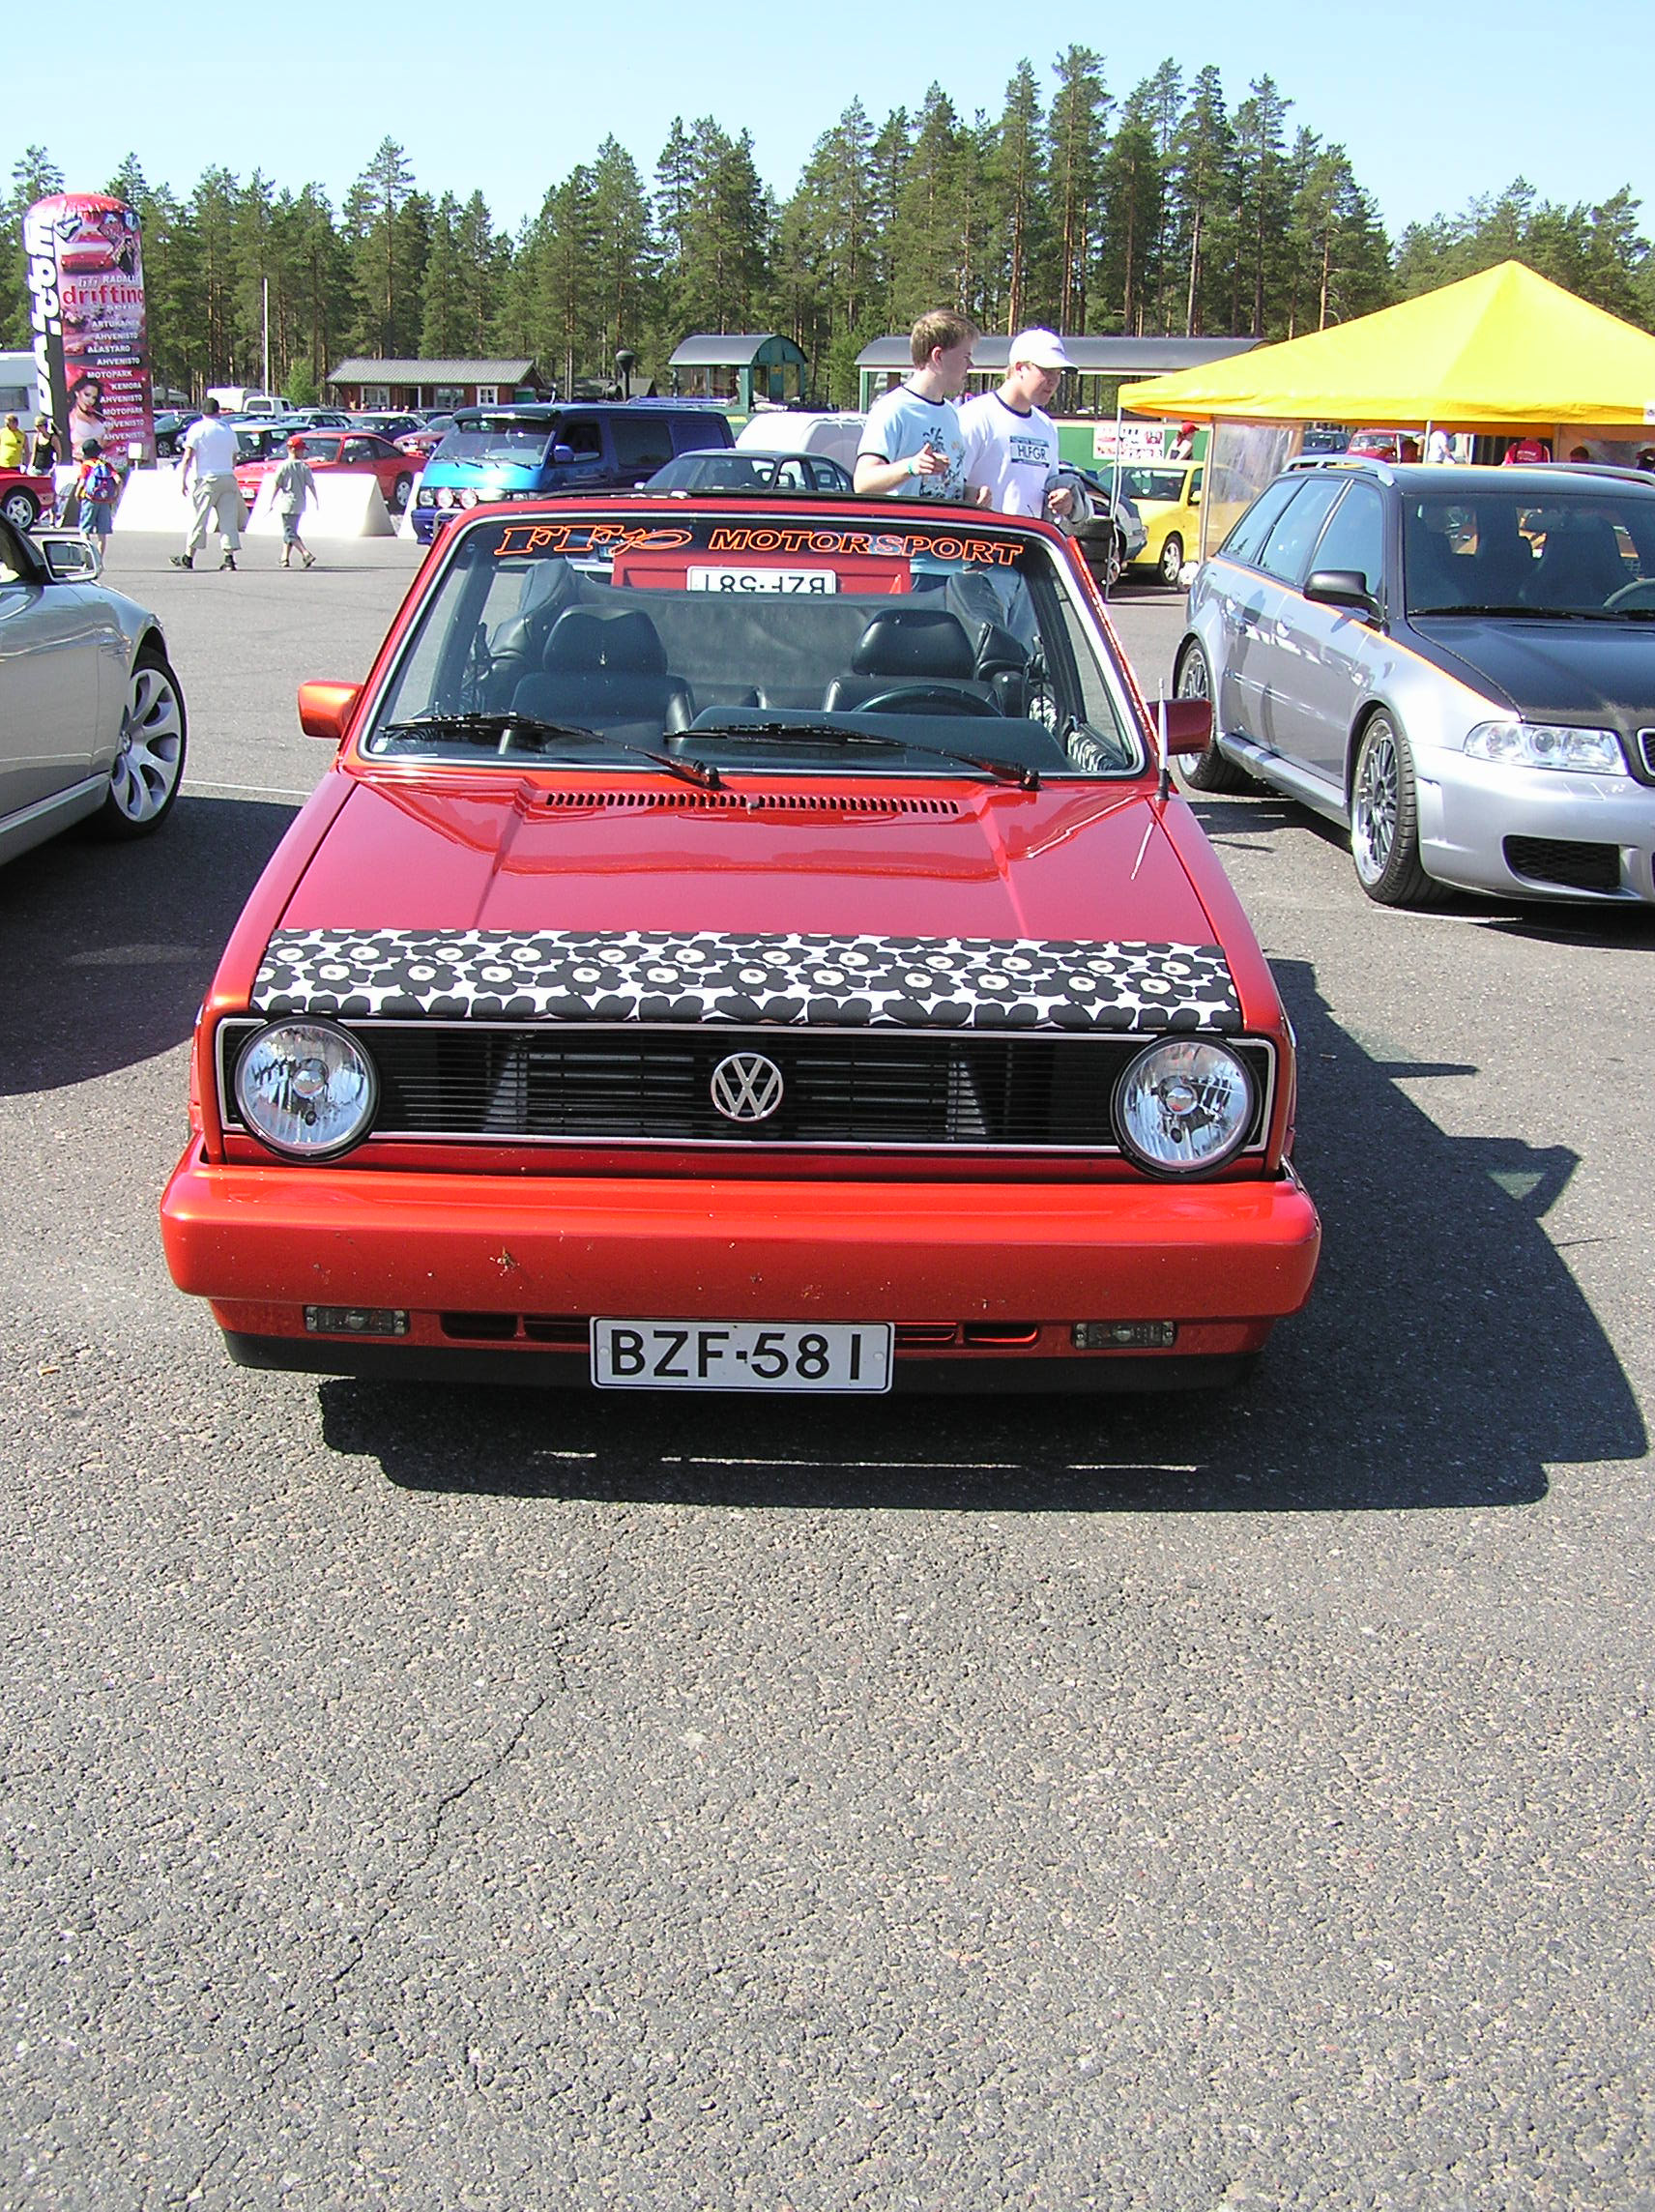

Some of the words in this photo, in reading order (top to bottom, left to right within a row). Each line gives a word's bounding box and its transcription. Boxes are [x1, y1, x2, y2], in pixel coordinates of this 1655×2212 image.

[87, 345, 131, 354] ALASTARO
[97, 357, 140, 365] AHVENISTO
[87, 370, 132, 379] MOTOPARK
[100, 394, 143, 404] AHVENISTO
[102, 407, 144, 417] MOTOPARK
[709, 529, 1024, 566] MOTORSPORT
[611, 1328, 862, 1381] BZF-581
